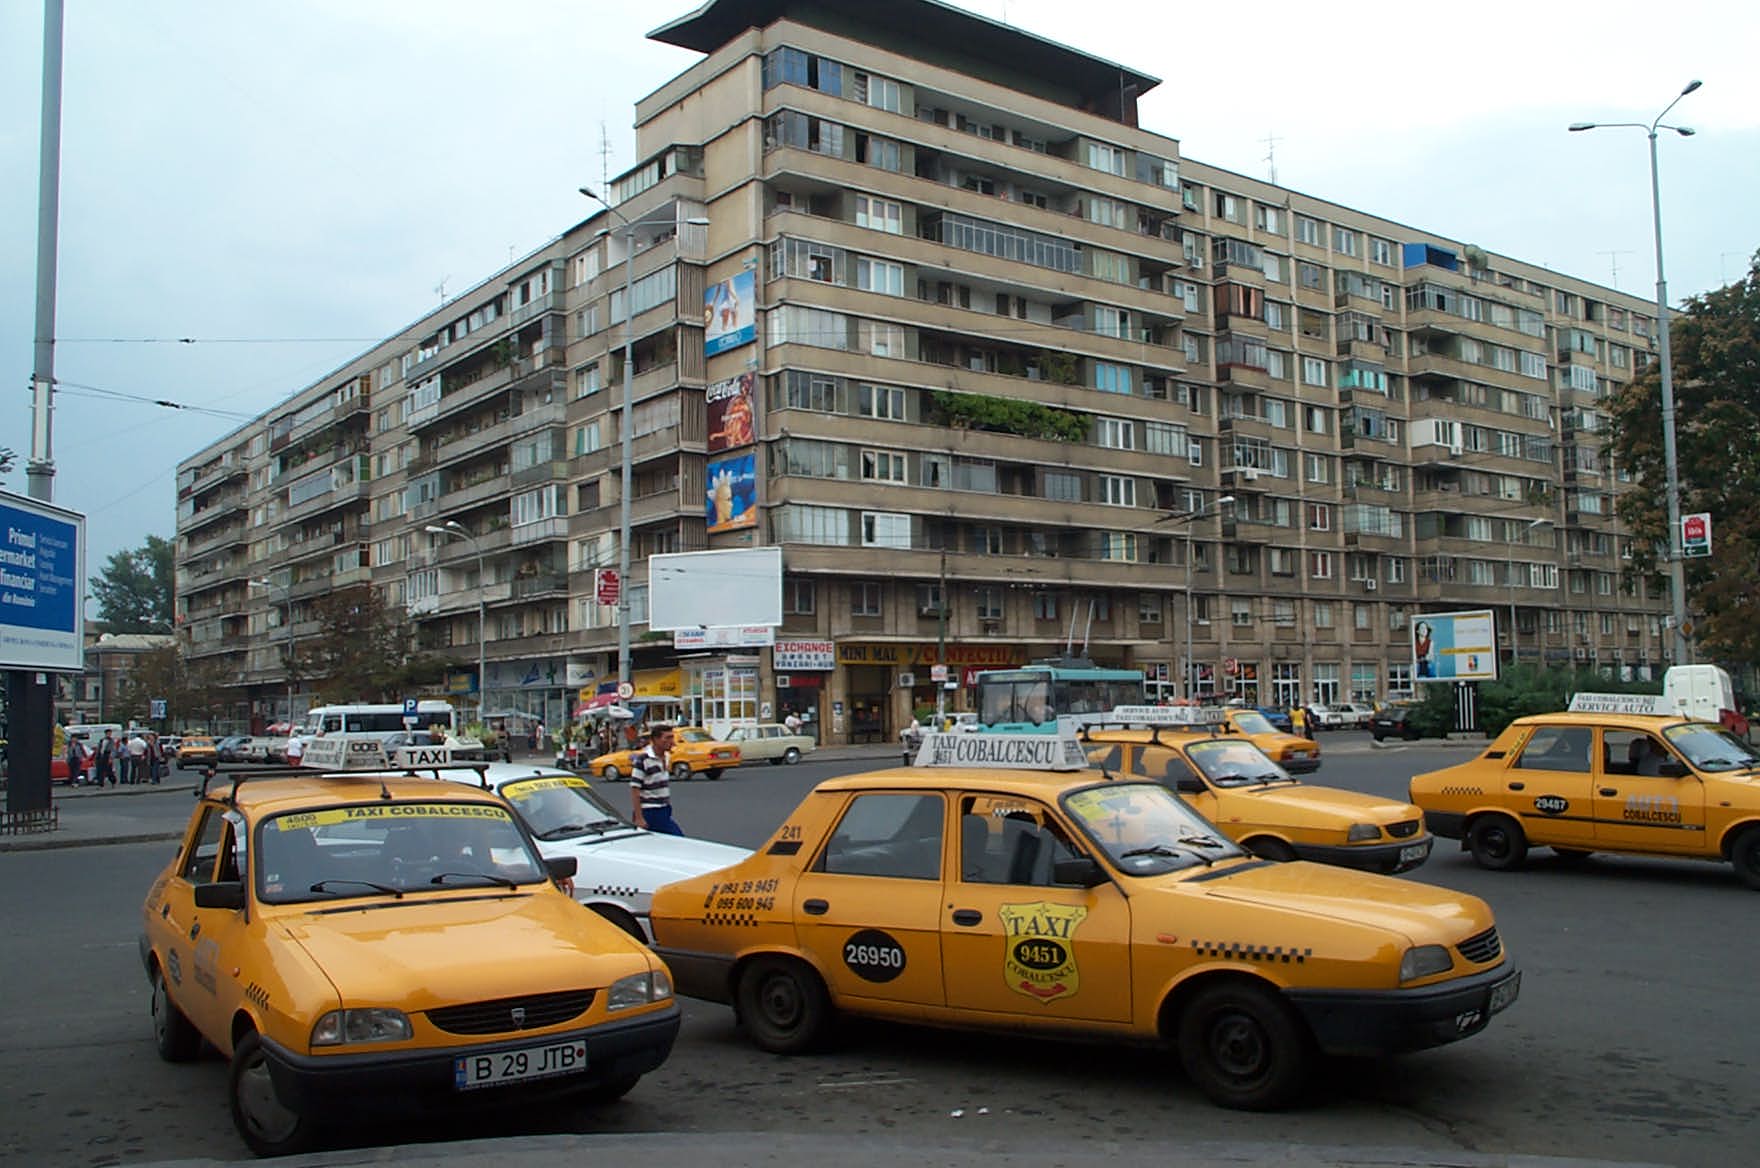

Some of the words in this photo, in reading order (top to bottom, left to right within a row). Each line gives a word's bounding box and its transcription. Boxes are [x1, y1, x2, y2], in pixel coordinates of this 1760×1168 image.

[8, 527, 36, 548] Primul
[776, 642, 832, 653] EXCHANGE
[406, 699, 416, 712] P
[1575, 702, 1617, 711] SERVICE
[1621, 703, 1655, 713] AUTO
[932, 735, 958, 749] TAXI
[957, 738, 1057, 764] COBALCESCU
[406, 750, 447, 765] TAXI
[345, 807, 384, 818] TAXI
[389, 806, 506, 819] COBALCESCU
[781, 825, 801, 839] 241
[755, 878, 779, 892] 9451
[1008, 915, 1072, 938] TAXI
[846, 943, 902, 968] 26950
[1020, 944, 1060, 964] 9451
[475, 1056, 492, 1080] B
[501, 1053, 529, 1077] 29
[537, 1045, 576, 1071] JTB
